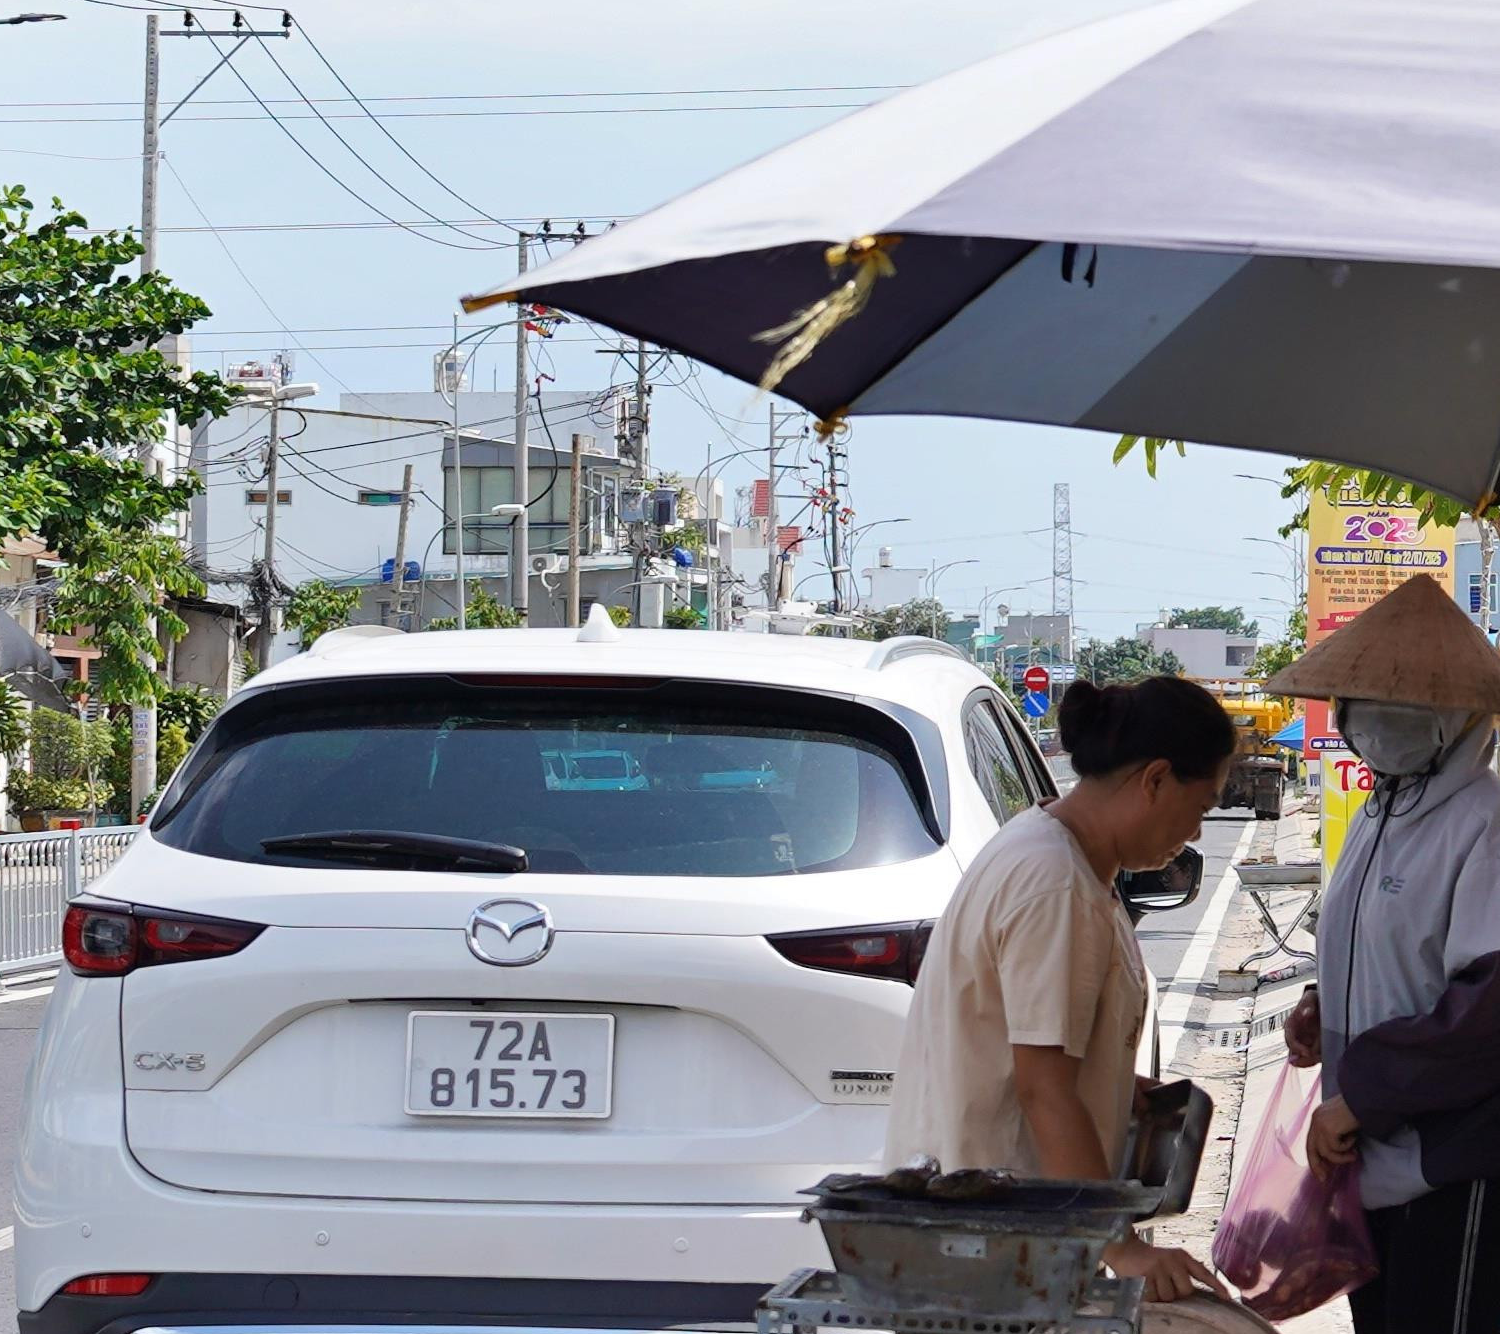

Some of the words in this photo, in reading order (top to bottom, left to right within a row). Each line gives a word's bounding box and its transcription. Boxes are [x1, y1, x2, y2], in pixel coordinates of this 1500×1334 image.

[1344, 516, 1425, 544] 2025
[469, 1021, 552, 1063] 72A
[133, 1051, 206, 1072] CX-5
[430, 1068, 588, 1110] 815.73
[833, 1083, 892, 1097] LUXUR
